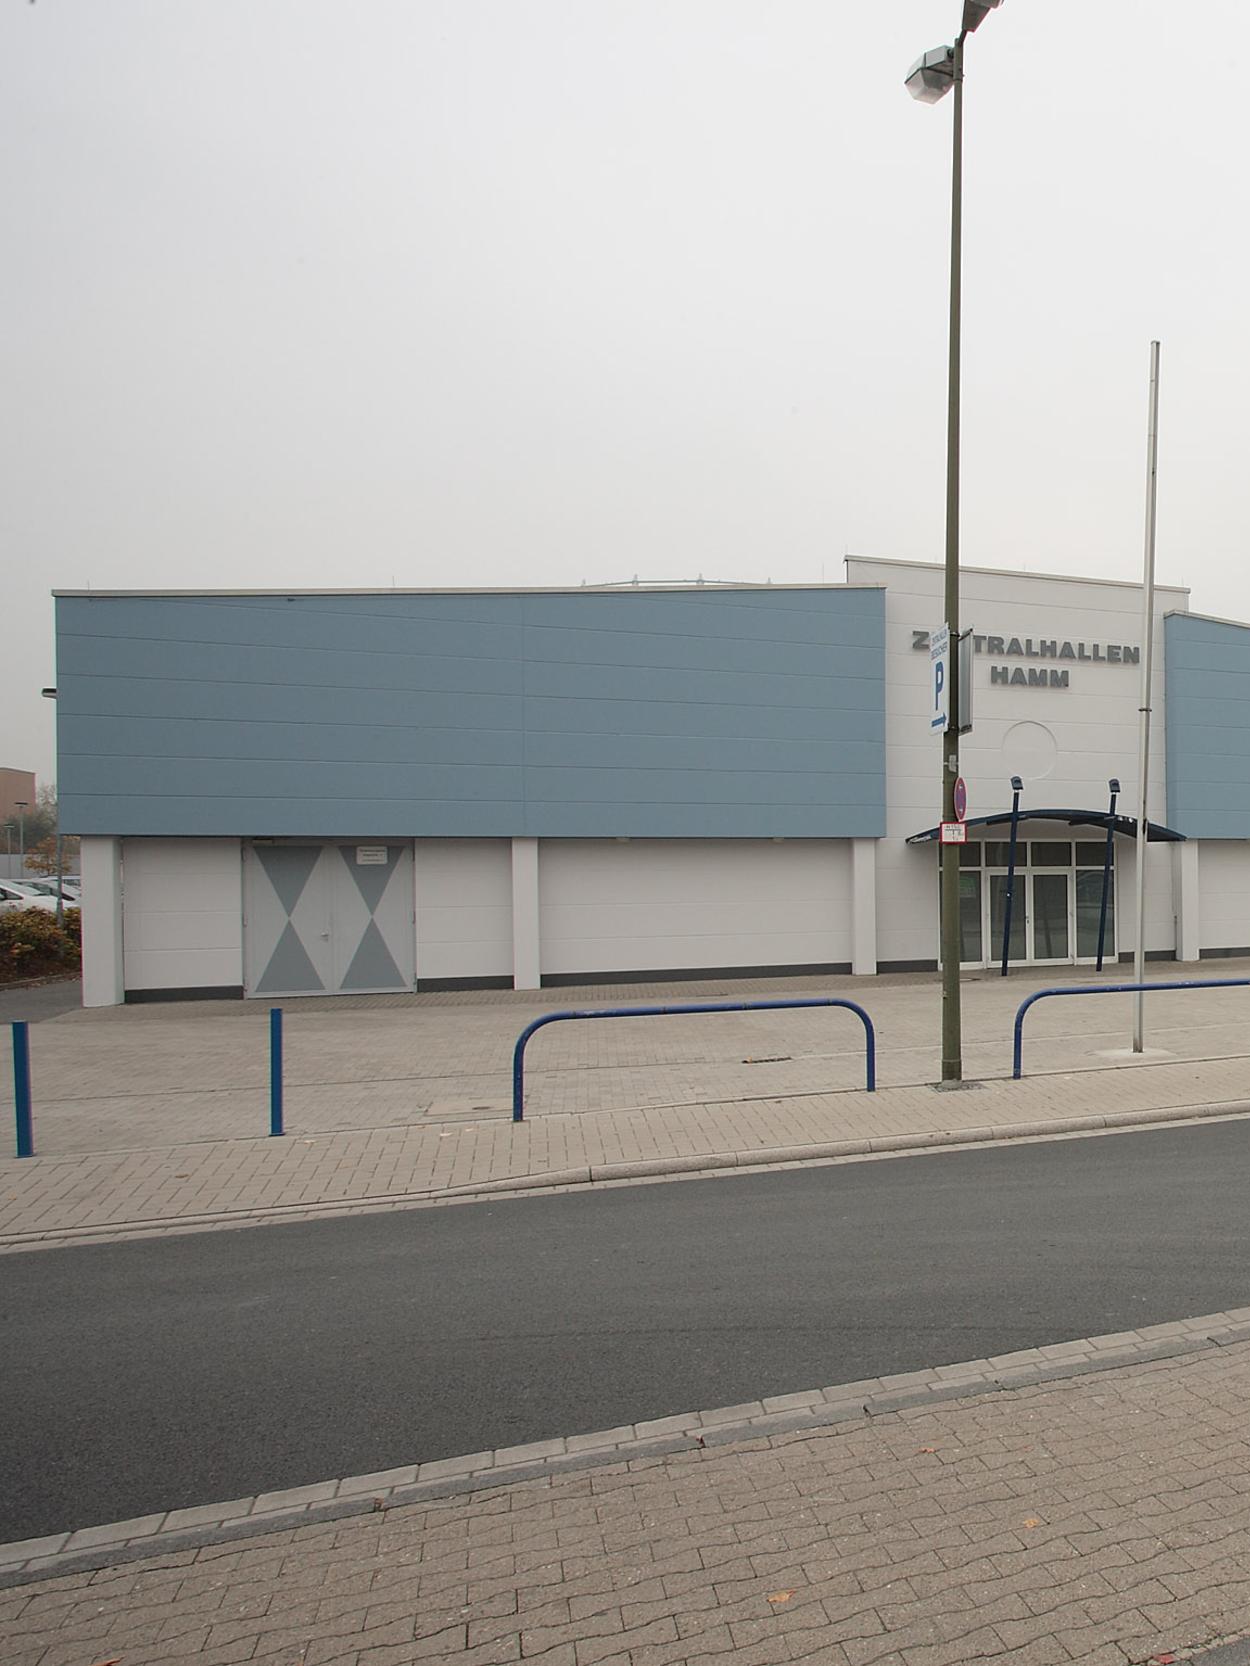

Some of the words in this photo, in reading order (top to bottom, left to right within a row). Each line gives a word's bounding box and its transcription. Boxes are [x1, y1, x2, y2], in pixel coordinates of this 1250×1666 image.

[912, 630, 1141, 664] ZTRALHALLEN
[935, 661, 944, 711] P
[990, 665, 1070, 688] HAMM
